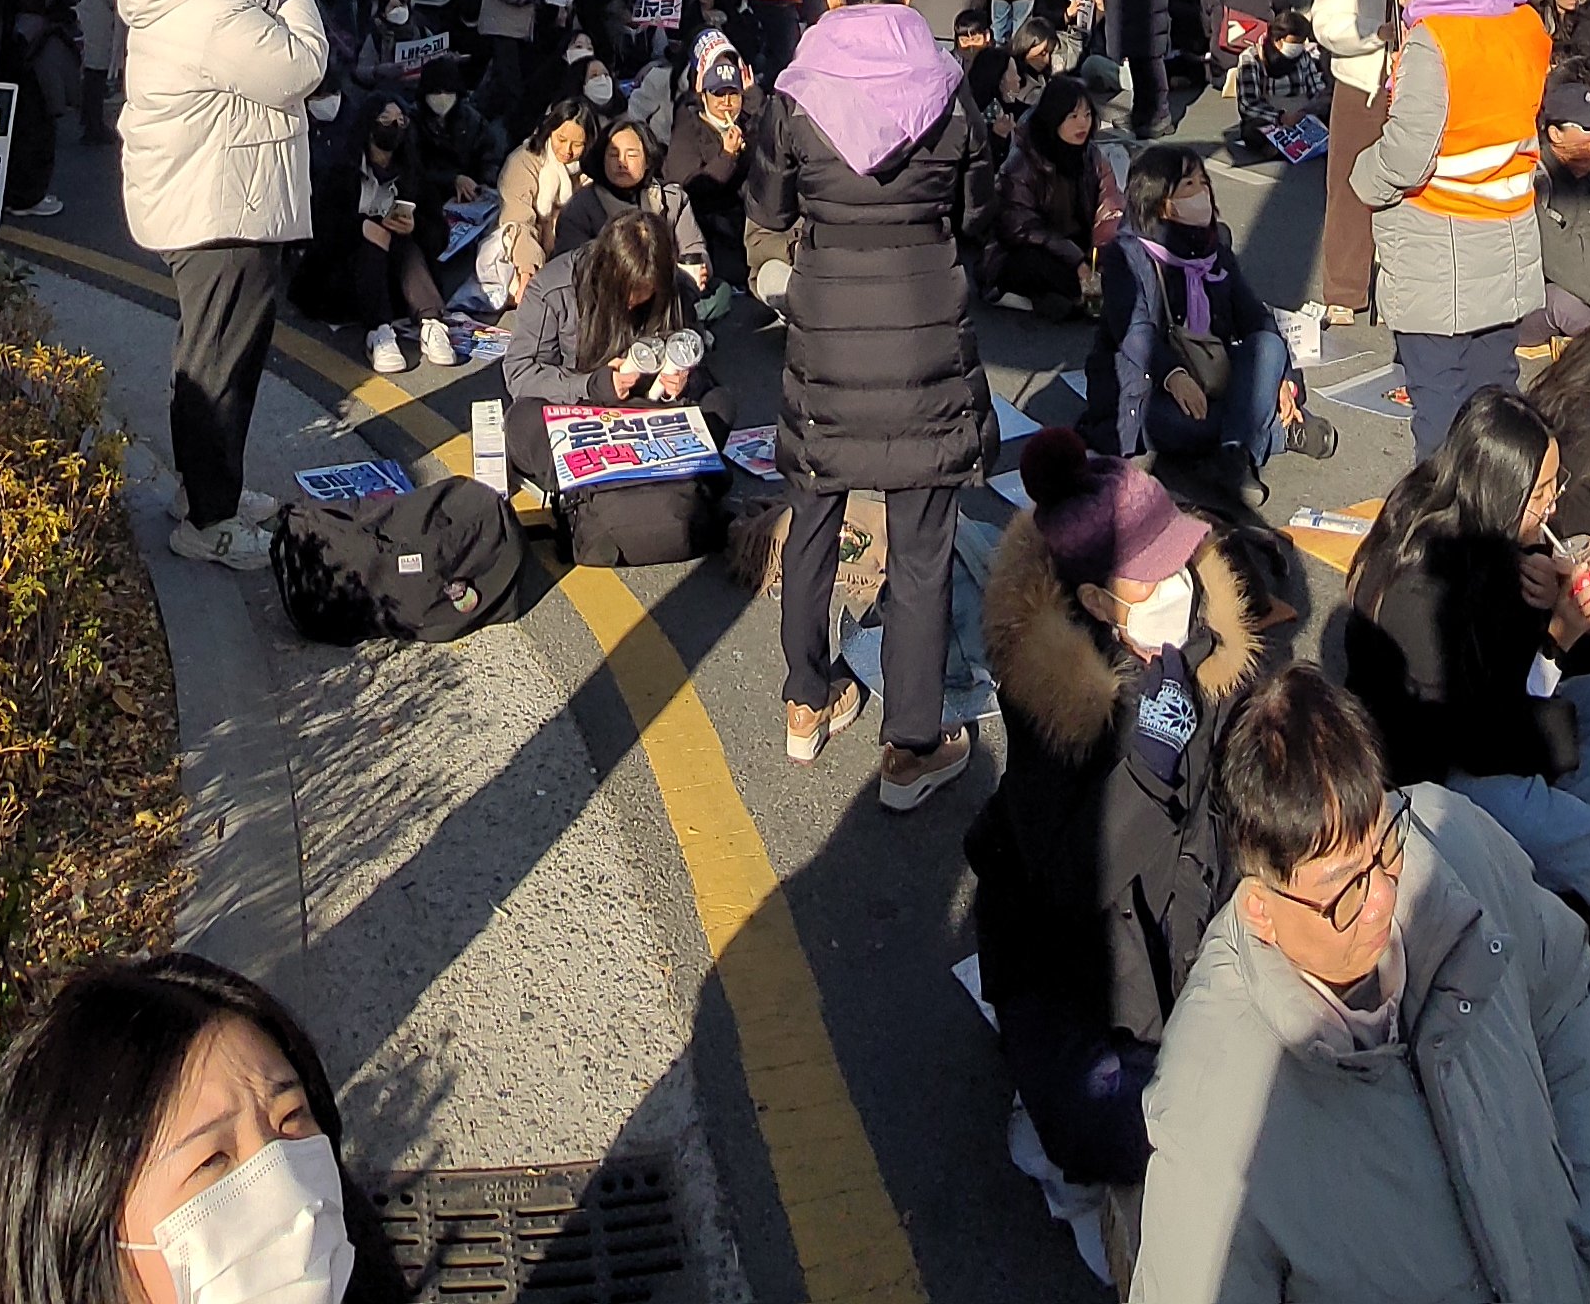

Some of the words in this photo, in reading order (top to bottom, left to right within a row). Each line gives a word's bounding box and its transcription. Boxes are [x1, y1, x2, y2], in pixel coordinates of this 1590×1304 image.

[567, 411, 690, 446] 윤석열
[560, 441, 641, 481] 탄핵
[637, 431, 709, 466] 체포
